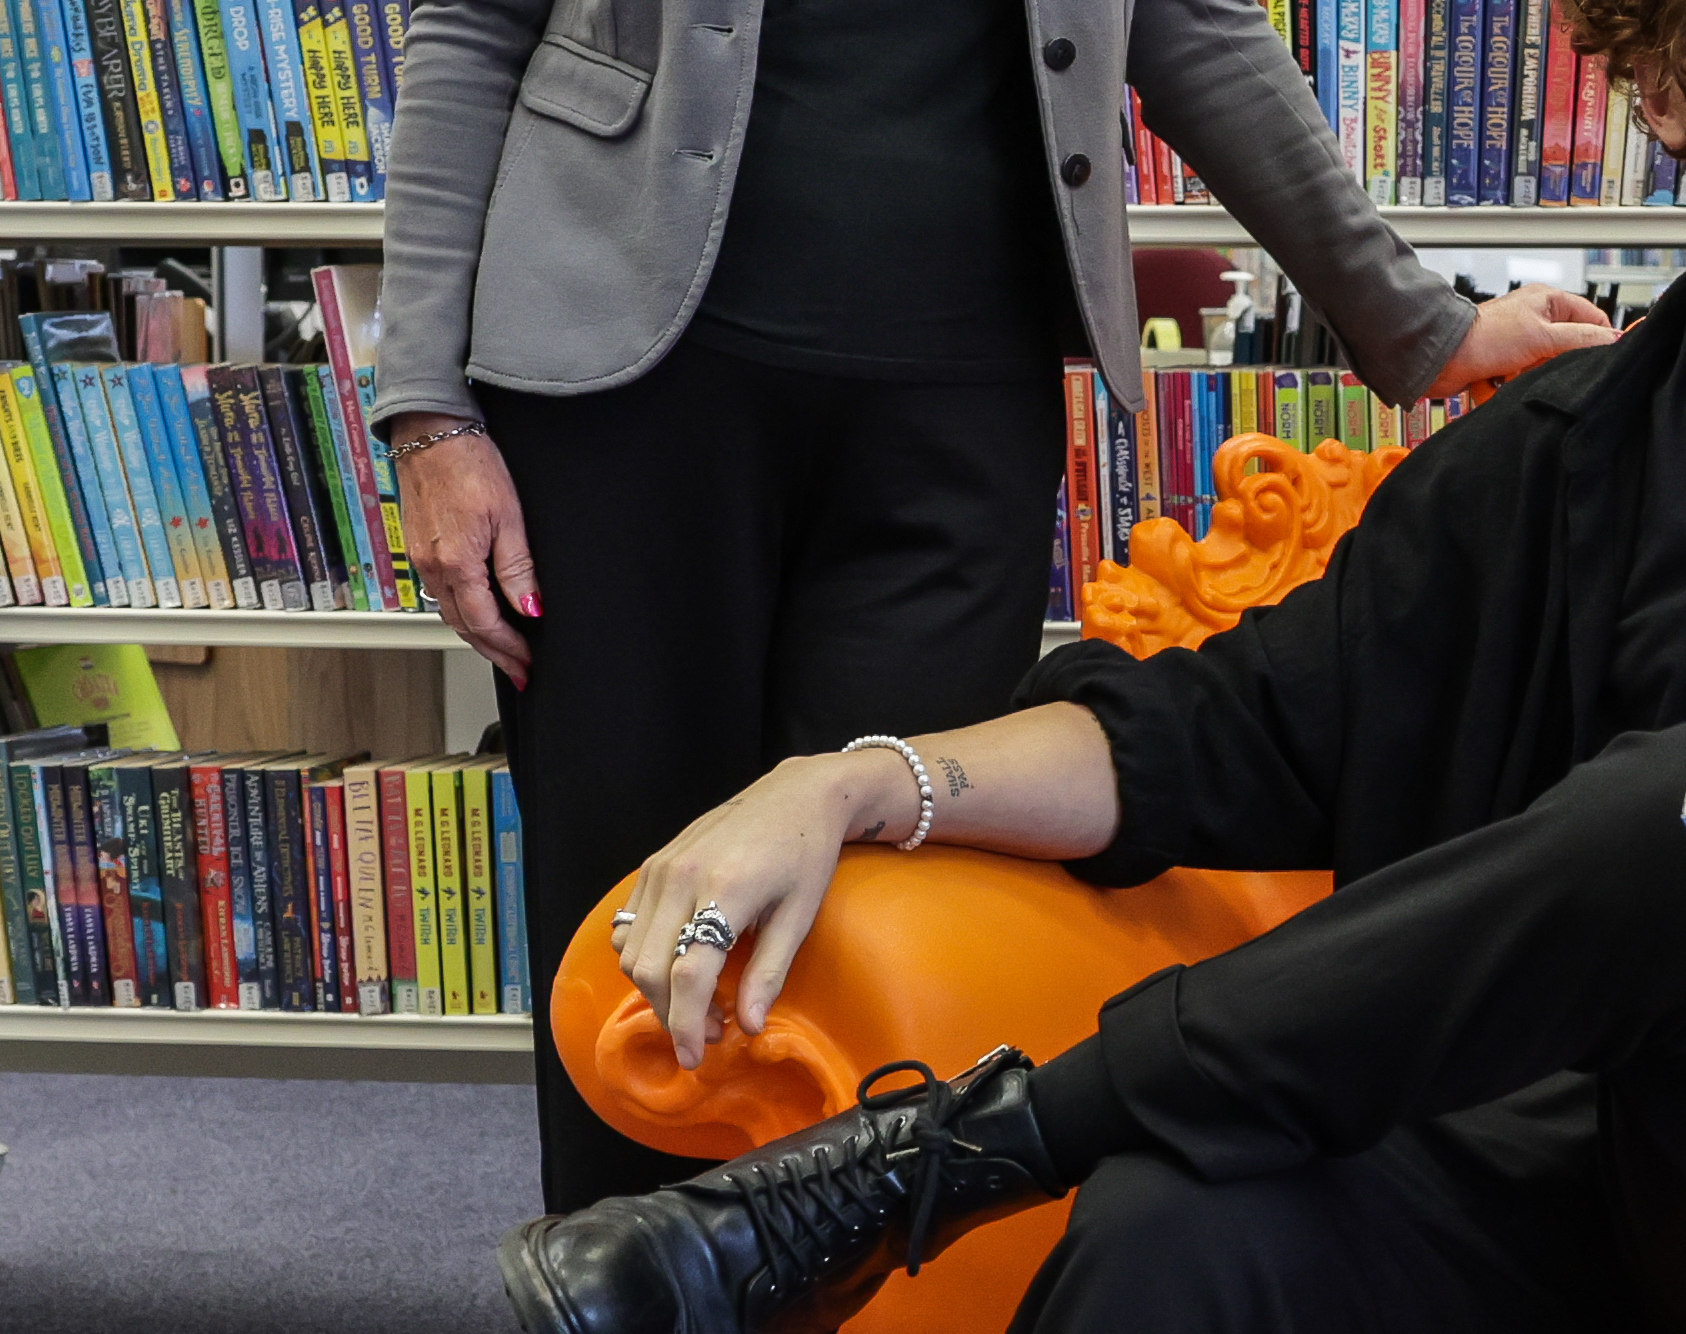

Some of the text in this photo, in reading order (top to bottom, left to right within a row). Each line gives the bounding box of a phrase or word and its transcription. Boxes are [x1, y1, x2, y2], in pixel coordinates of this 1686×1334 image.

[230, 6, 250, 51] DROP
[353, 4, 373, 48] GOOD
[384, 3, 404, 48] GOOD
[1460, 15, 1477, 34] The
[130, 40, 149, 93] Drama
[274, 45, 299, 118] MYSTERY
[361, 54, 381, 99] TURN
[1340, 63, 1360, 112] BINNY
[1430, 59, 1445, 113] TRAVELLER
[1453, 35, 1480, 91] COLOUR
[1486, 15, 1511, 150] The COLOUR HOPE
[1521, 48, 1539, 121] EMPORIUM
[318, 95, 335, 129] HERE
[342, 96, 360, 129] HERE
[1369, 50, 1392, 171] BINNY Short
[1452, 105, 1475, 149] HOPE
[1280, 402, 1292, 439] NORM
[1313, 399, 1324, 436] NORM
[230, 536, 246, 576] KESSLER
[137, 805, 151, 835] UKI
[159, 792, 174, 878] GRIMHEART
[194, 798, 210, 855] HUNTED
[205, 783, 225, 856] CARNIVAL
[223, 774, 241, 843] PRISONER
[245, 774, 262, 848] ADVENTURE
[274, 788, 289, 840] ELEMENTAL
[170, 810, 184, 865] BEASTS
[252, 864, 269, 914] ATHENS
[355, 850, 376, 910] QUEEN
[415, 830, 431, 945] LEONARD TWITCH
[441, 830, 457, 945] LEONARD TWITCH
[471, 830, 486, 945] LEONARD TWITCH
